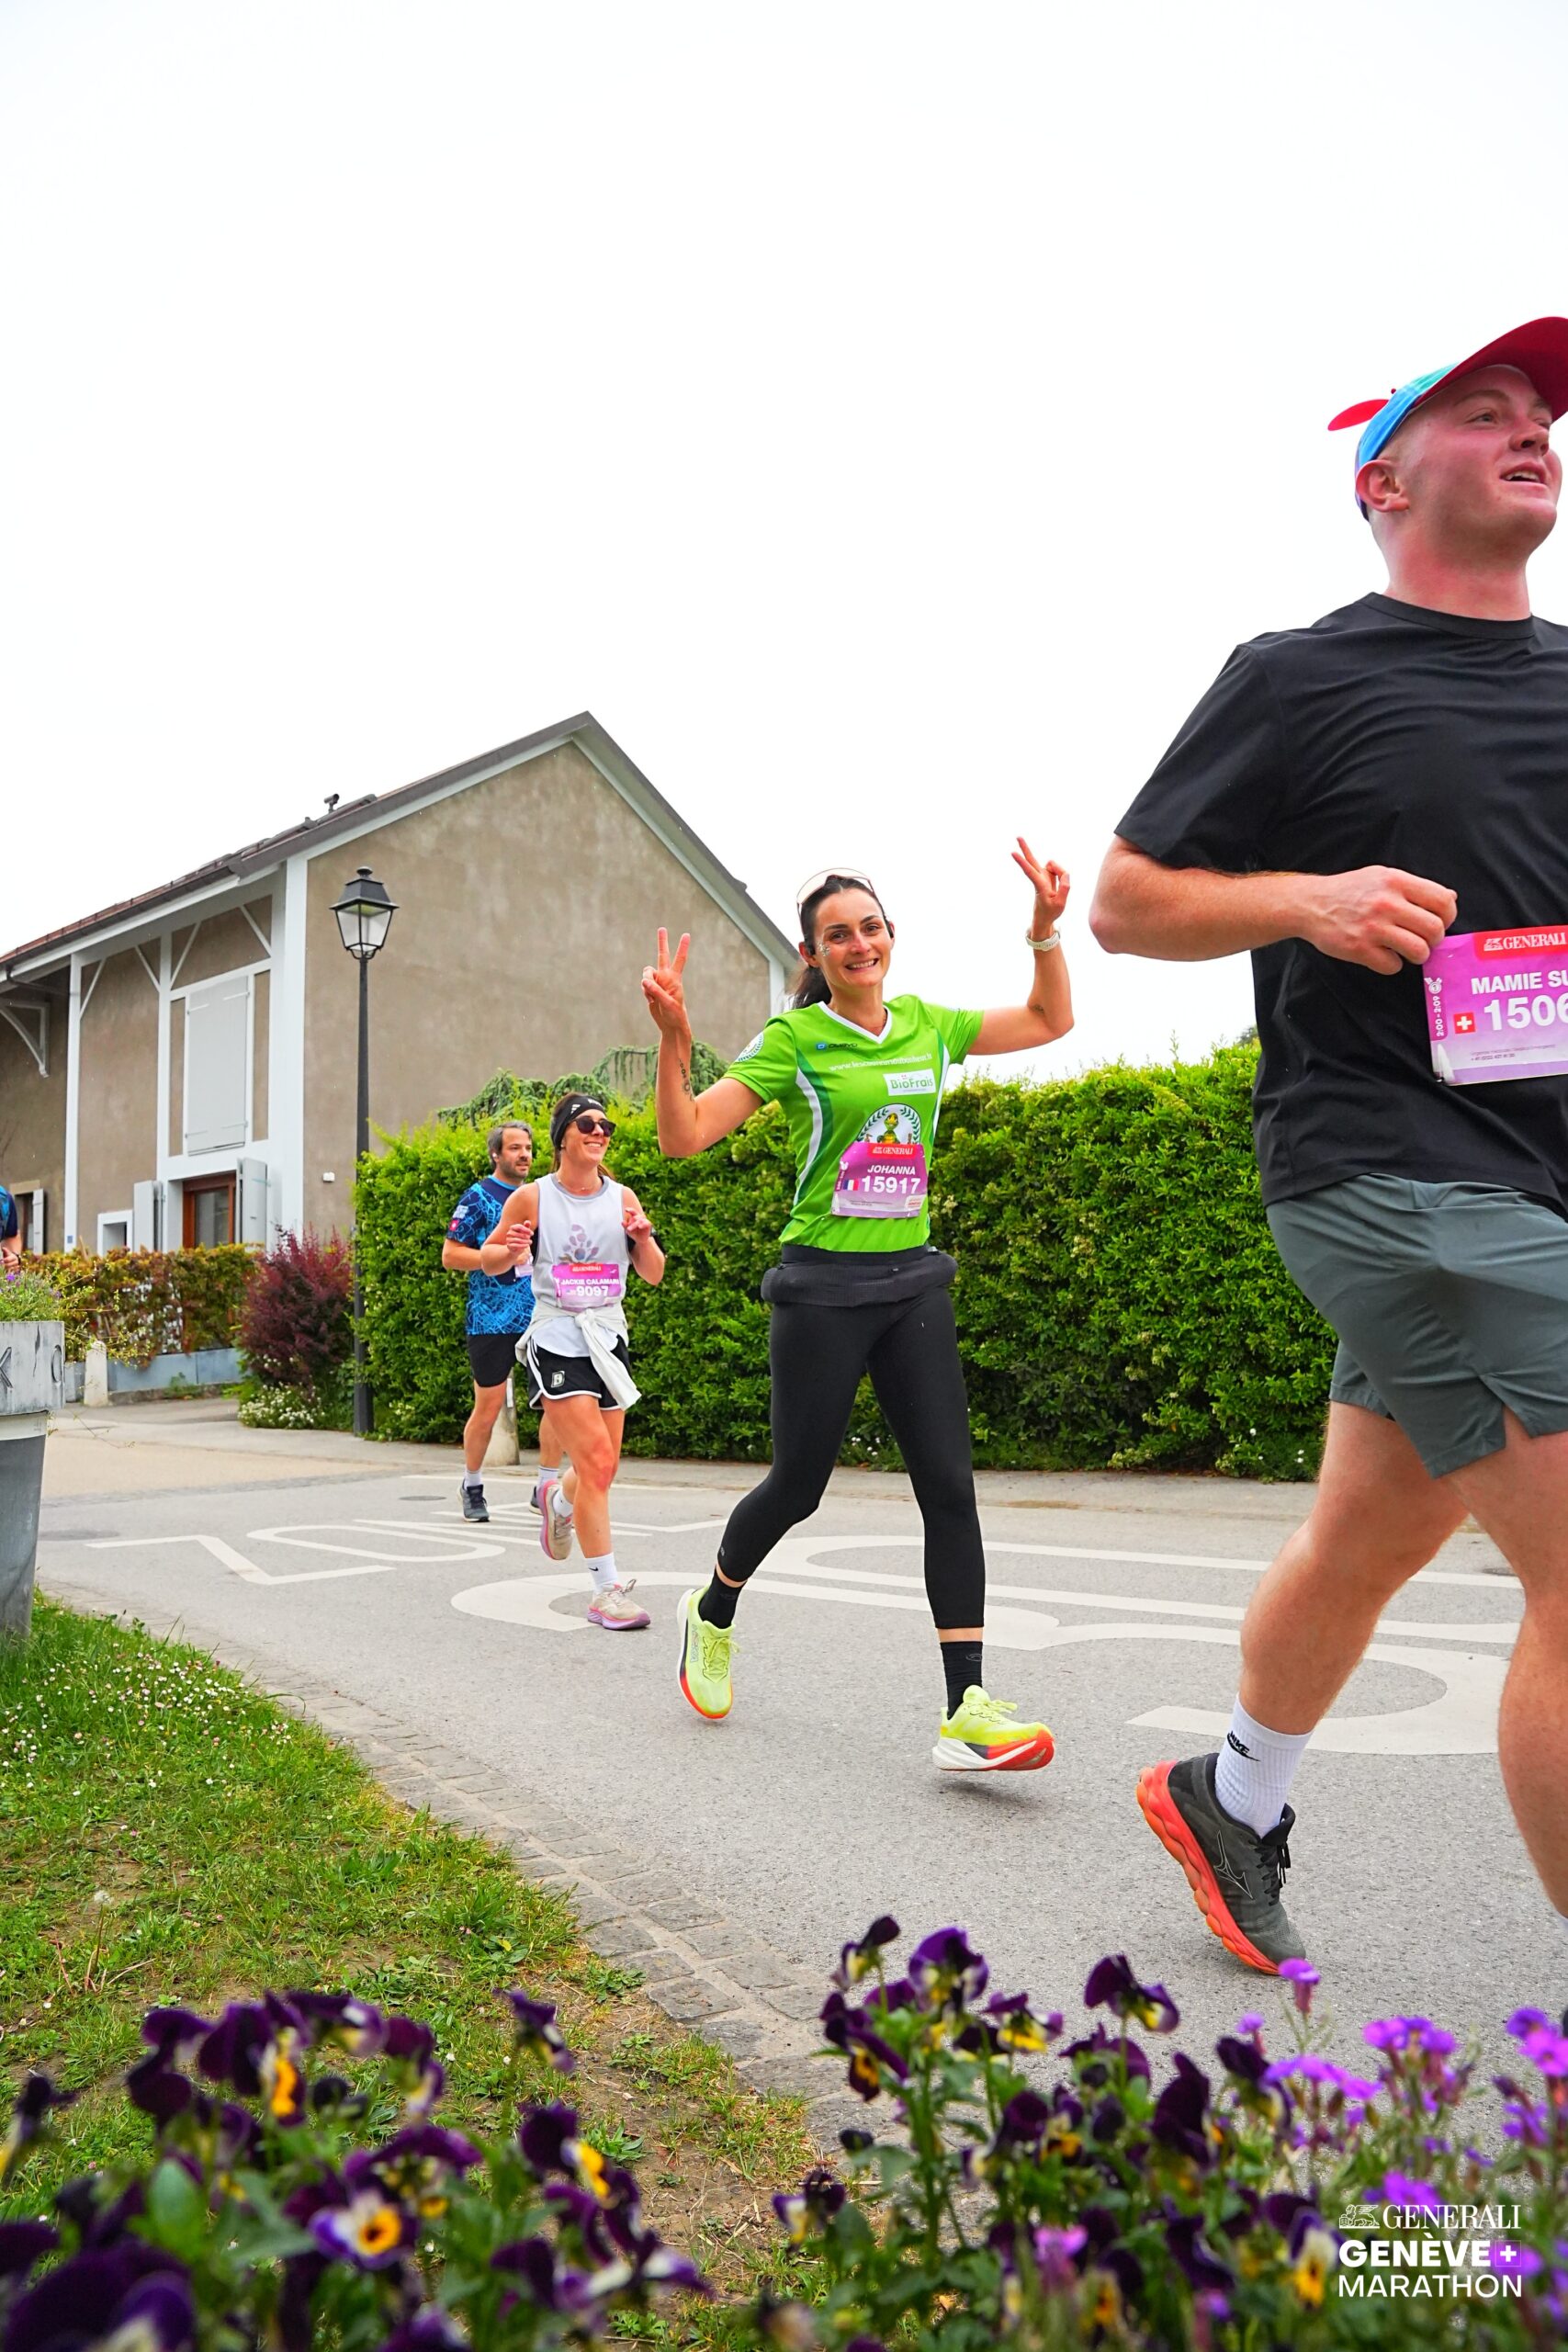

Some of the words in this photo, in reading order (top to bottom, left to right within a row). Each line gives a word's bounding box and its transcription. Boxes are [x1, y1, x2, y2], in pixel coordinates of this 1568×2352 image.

[1503, 933, 1567, 949] GENERALI
[1471, 972, 1543, 995] MAMIE
[890, 1076, 933, 1090] BioFrais
[883, 1147, 913, 1155] GENERALI
[867, 1164, 916, 1175] JOHANNA
[862, 1175, 921, 1194] 15917
[576, 1285, 609, 1297] 9097
